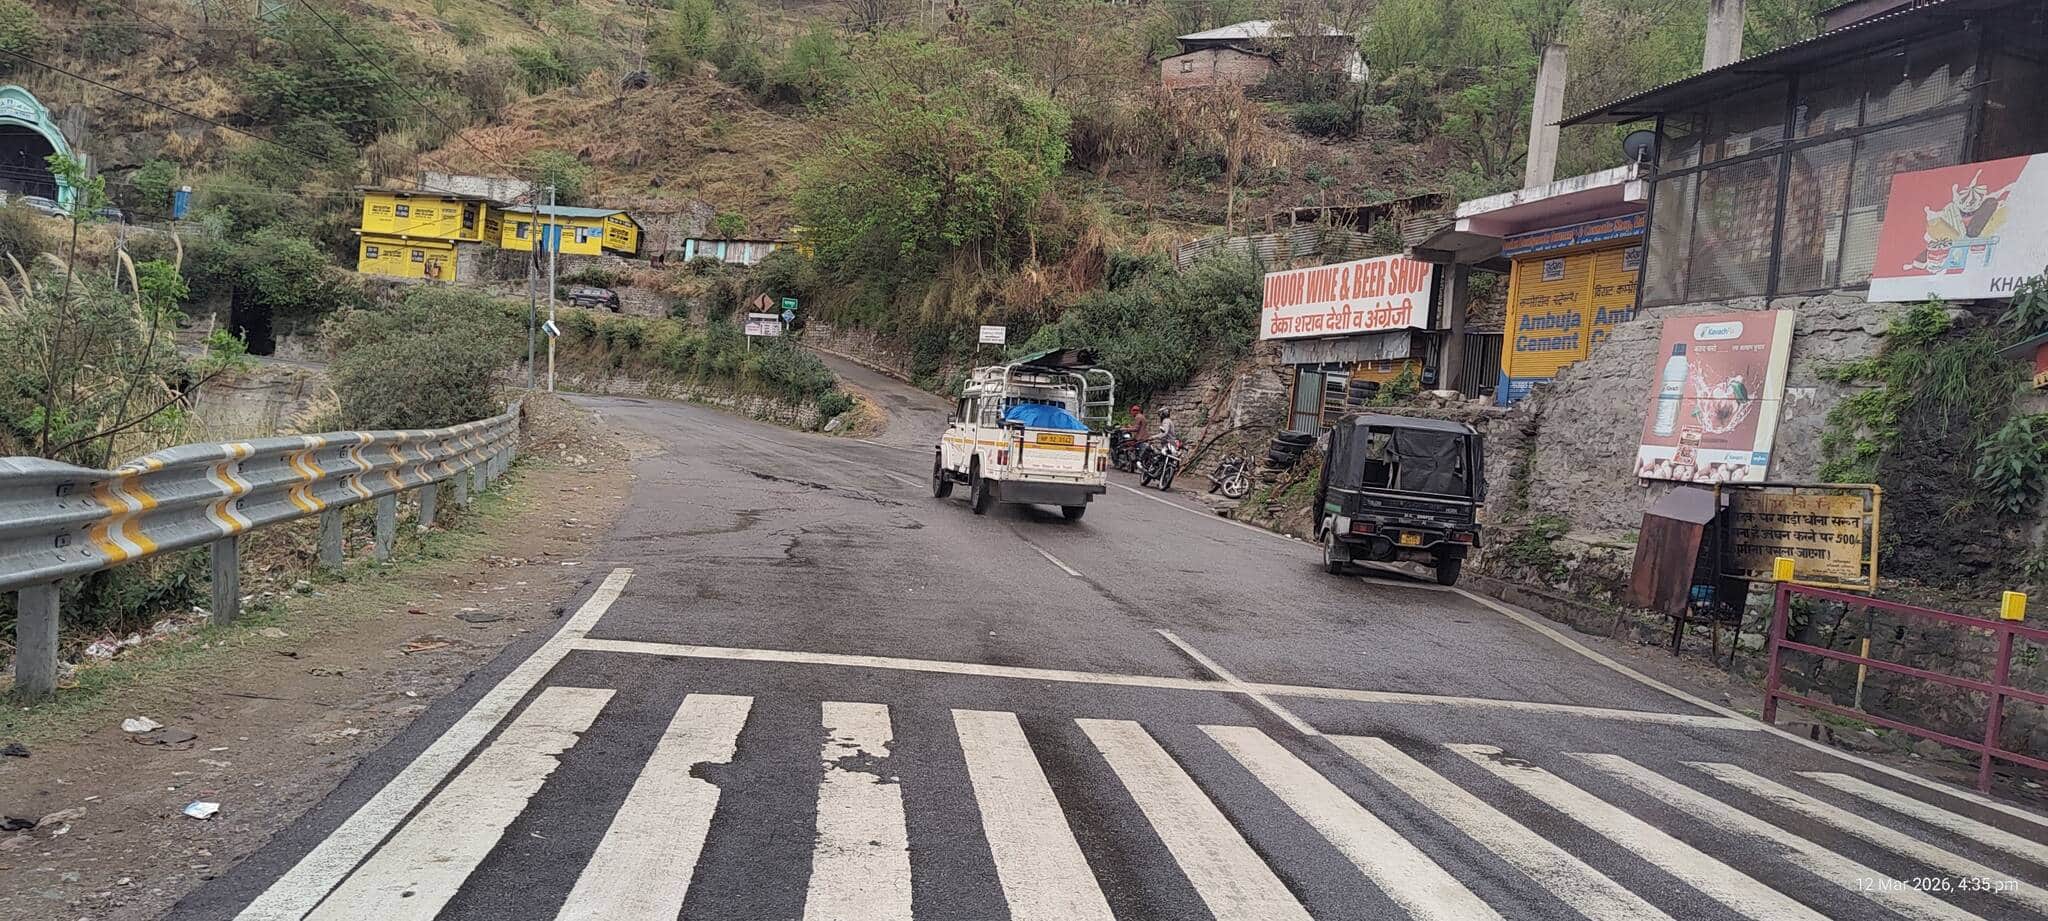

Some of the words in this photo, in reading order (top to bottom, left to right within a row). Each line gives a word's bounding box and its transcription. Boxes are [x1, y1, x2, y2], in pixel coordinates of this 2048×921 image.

[1264, 272, 1305, 312] LIQUOR
[1306, 267, 1339, 304] WINE
[1340, 267, 1351, 299] &
[1352, 259, 1387, 300] BEER
[1388, 257, 1429, 296] SHOP
[1271, 309, 1292, 335] ठेका
[1294, 313, 1324, 332] शराब
[1326, 304, 1351, 330] देशी
[1353, 309, 1364, 329] व
[1365, 298, 1413, 329] अंग्रेजी
[1519, 308, 1581, 331] Ambuja
[1516, 333, 1579, 352] Cement
[1736, 512, 1756, 524] ड़क
[1758, 512, 1775, 523] पर
[1802, 511, 1830, 526] धोना
[1736, 527, 1750, 538] ना
[1793, 529, 1819, 543] करने
[1820, 533, 1834, 543] पर
